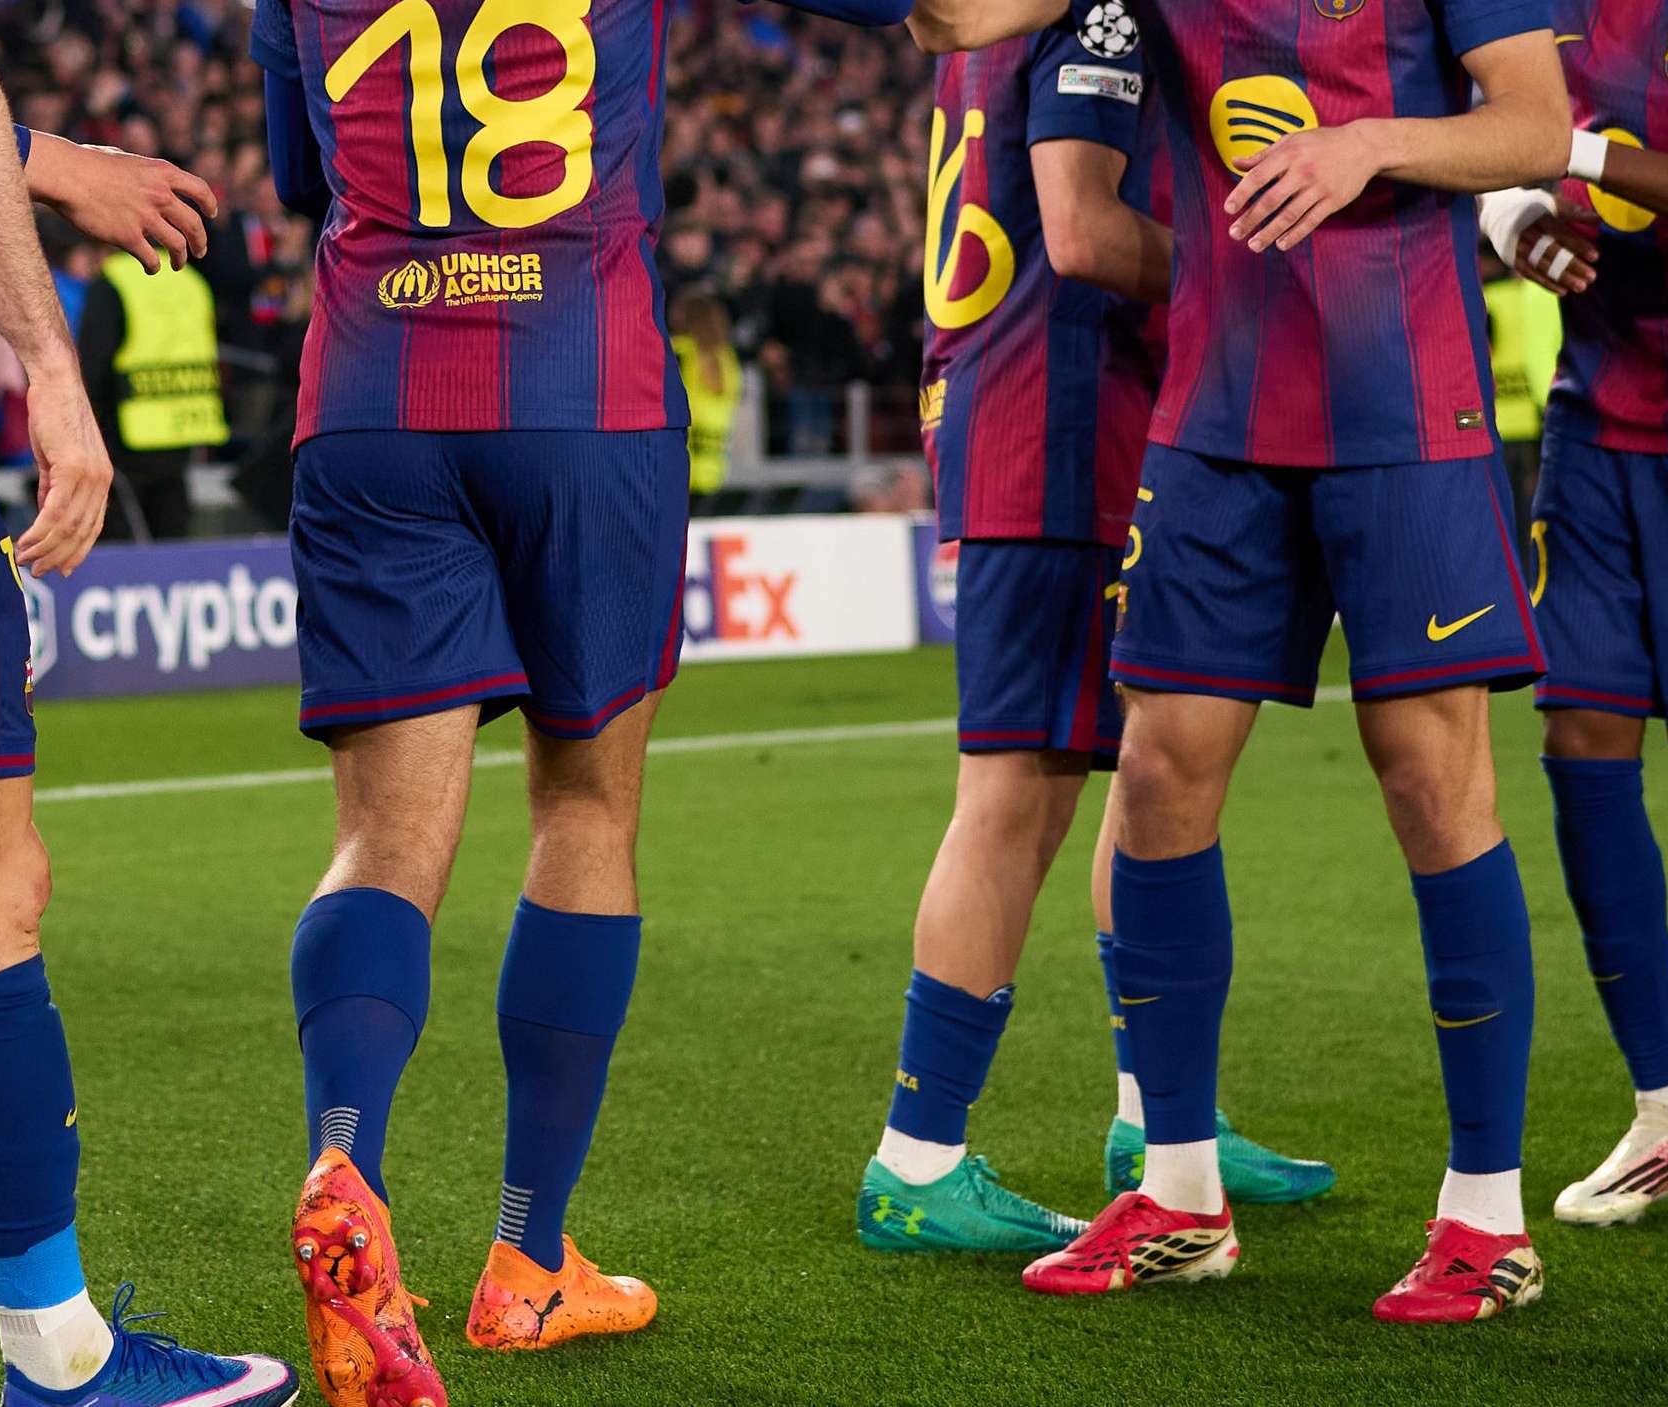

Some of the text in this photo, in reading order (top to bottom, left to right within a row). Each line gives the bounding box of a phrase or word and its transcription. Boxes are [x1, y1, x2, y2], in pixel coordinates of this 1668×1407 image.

[441, 252, 541, 276] UNHCR
[444, 273, 543, 299] ACNUR
[445, 292, 543, 308] The UN Refugee Agency
